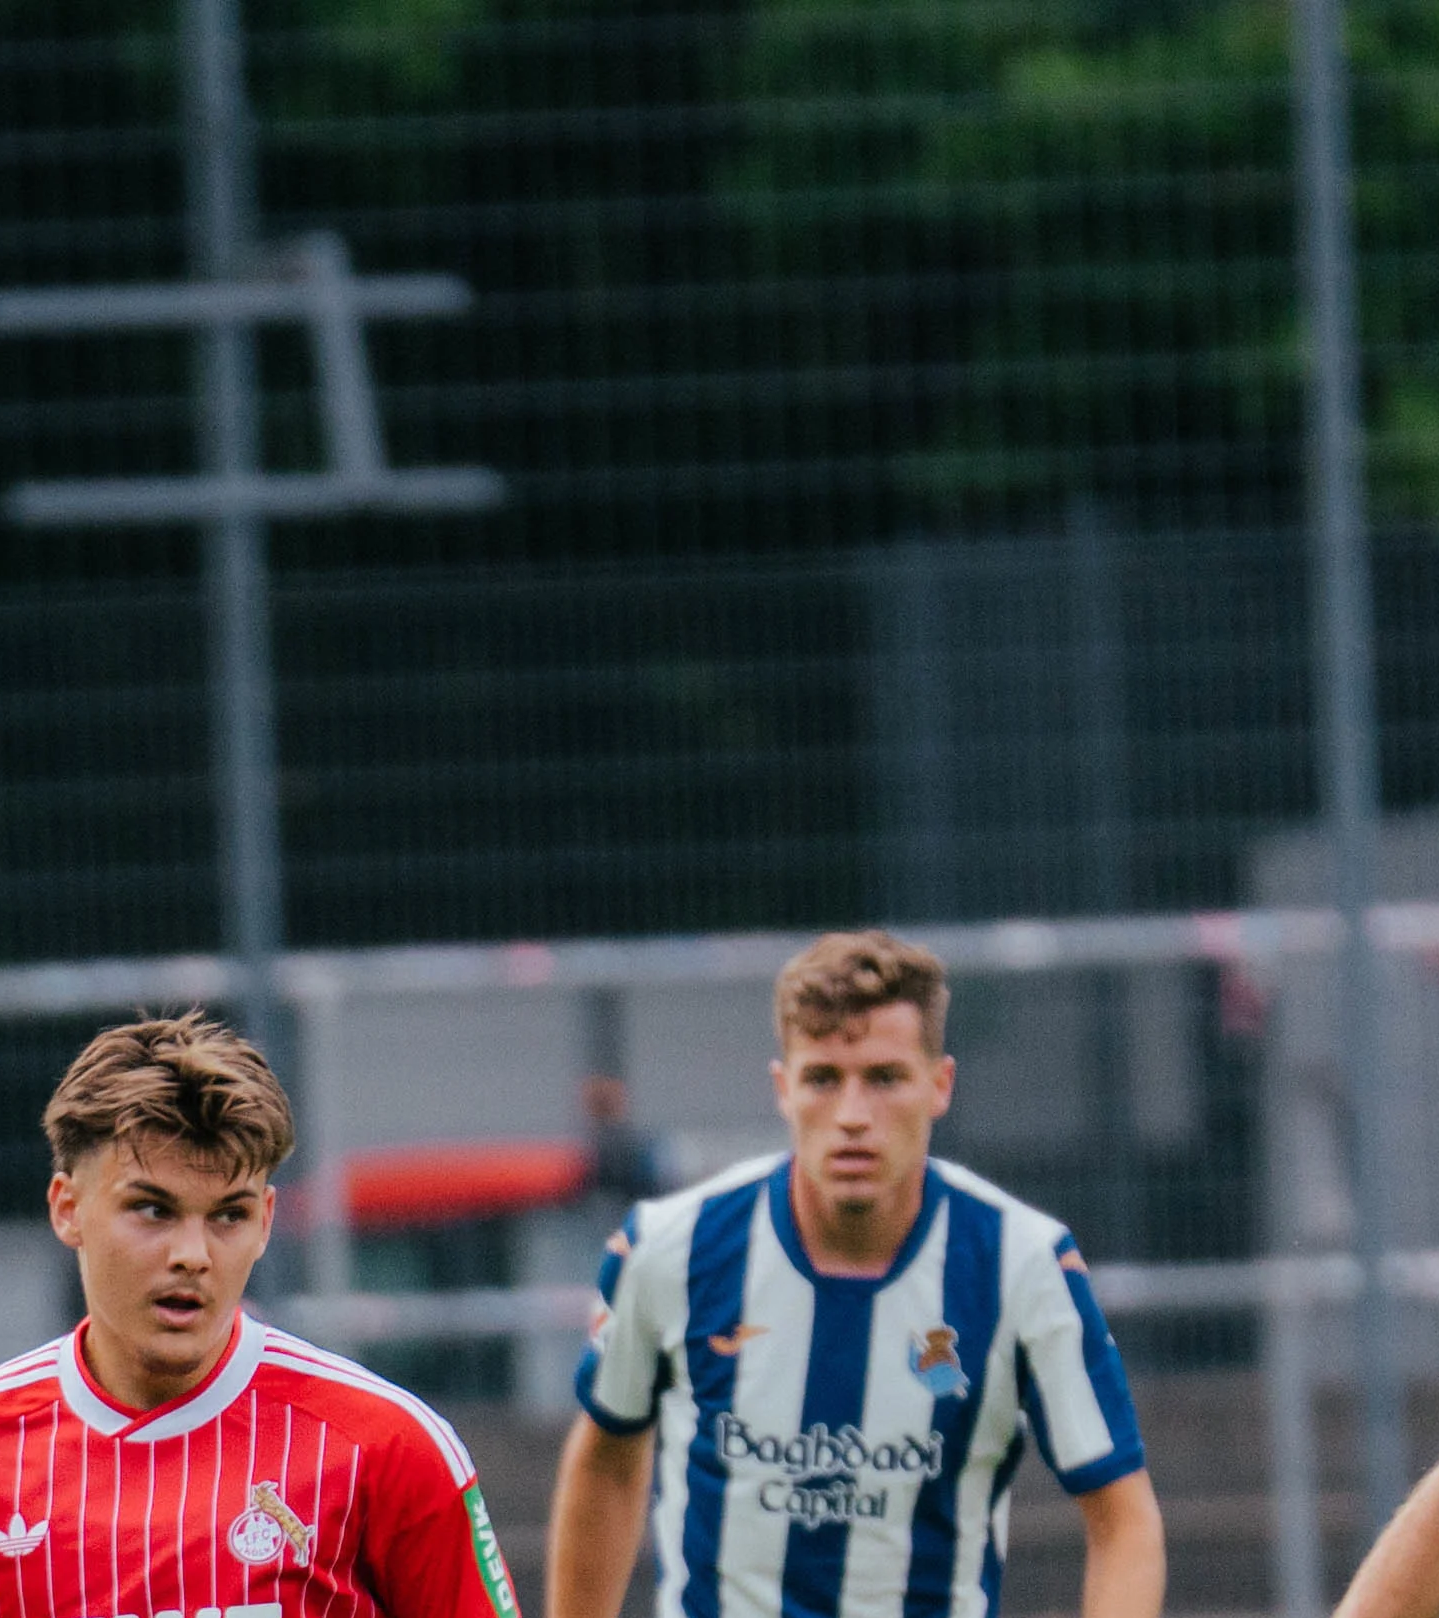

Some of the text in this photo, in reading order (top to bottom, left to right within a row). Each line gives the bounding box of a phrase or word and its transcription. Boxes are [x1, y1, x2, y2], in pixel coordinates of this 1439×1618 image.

[718, 1413, 943, 1481] Baghdadi
[759, 1480, 889, 1530] Capital
[473, 1498, 514, 1612] DEVK
